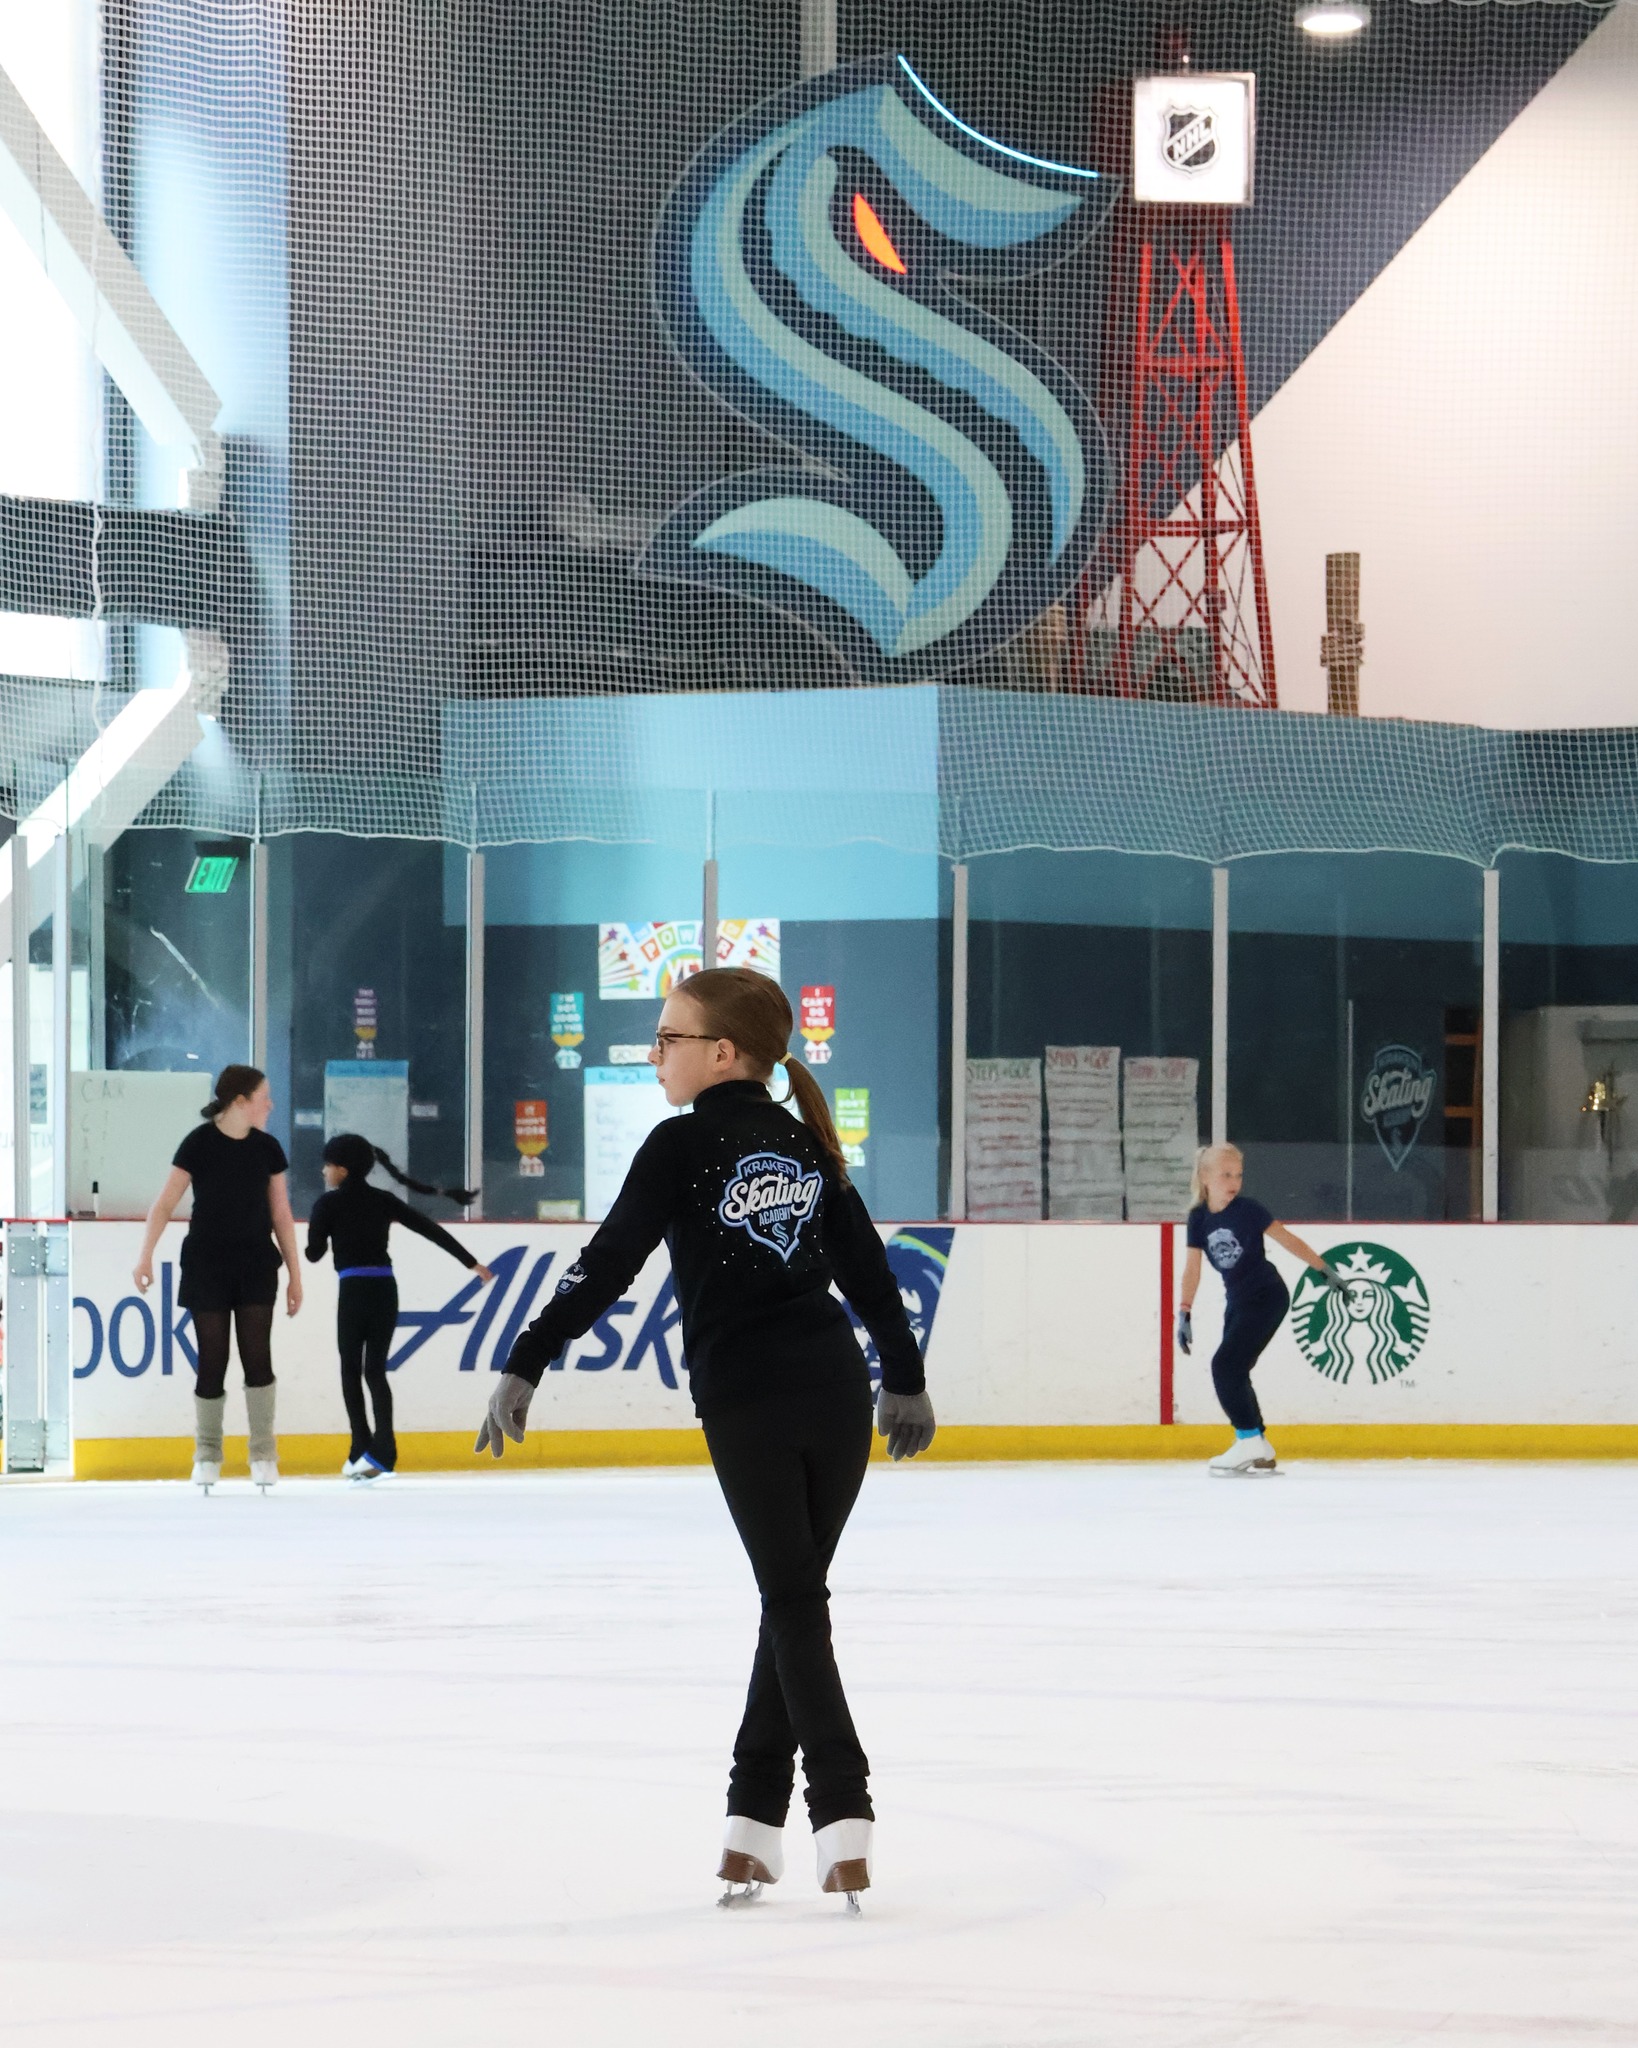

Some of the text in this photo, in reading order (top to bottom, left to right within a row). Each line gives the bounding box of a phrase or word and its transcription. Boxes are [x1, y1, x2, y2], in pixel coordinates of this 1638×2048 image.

[1172, 120, 1213, 162] NHL
[192, 857, 234, 891] EXIT
[1363, 1066, 1434, 1119] Skating
[743, 1160, 796, 1178] KRAKEN
[724, 1172, 818, 1220] Skating
[758, 1206, 793, 1227] ACADEMY
[386, 1246, 691, 1390] Alsk
